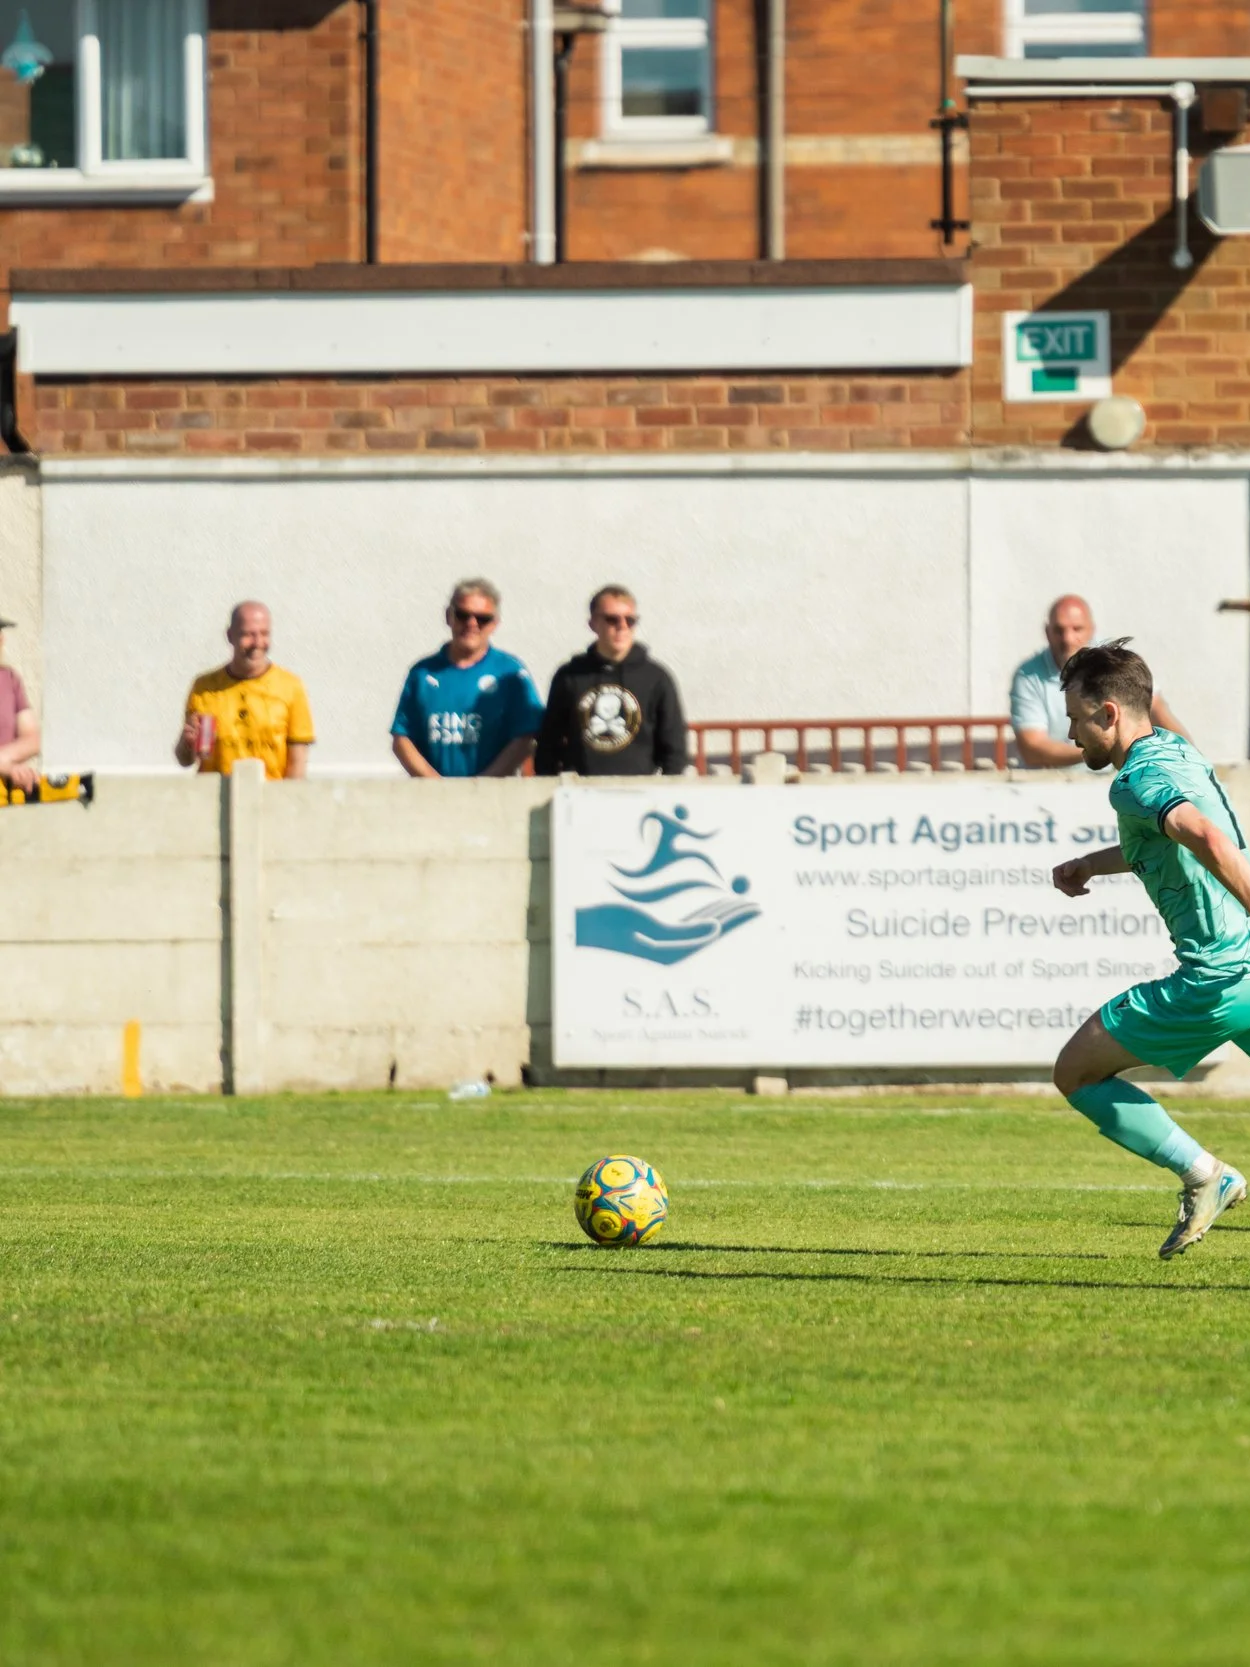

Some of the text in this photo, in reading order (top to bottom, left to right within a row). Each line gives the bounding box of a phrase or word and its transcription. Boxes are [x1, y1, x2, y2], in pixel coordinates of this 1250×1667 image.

[1021, 325, 1091, 357] EXIT
[428, 711, 482, 729] KING
[793, 815, 898, 853] Sport
[911, 813, 1057, 853] Against
[847, 906, 1161, 938] Suicide Prevention
[793, 960, 871, 985] Kicking
[879, 959, 957, 979] Suicide
[964, 961, 997, 979] out
[1004, 960, 1025, 979] of
[1032, 958, 1089, 982] Sport
[1096, 958, 1156, 978] Since
[620, 986, 721, 1020] S.A.S.
[796, 1001, 1094, 1037] #togetherwecreate
